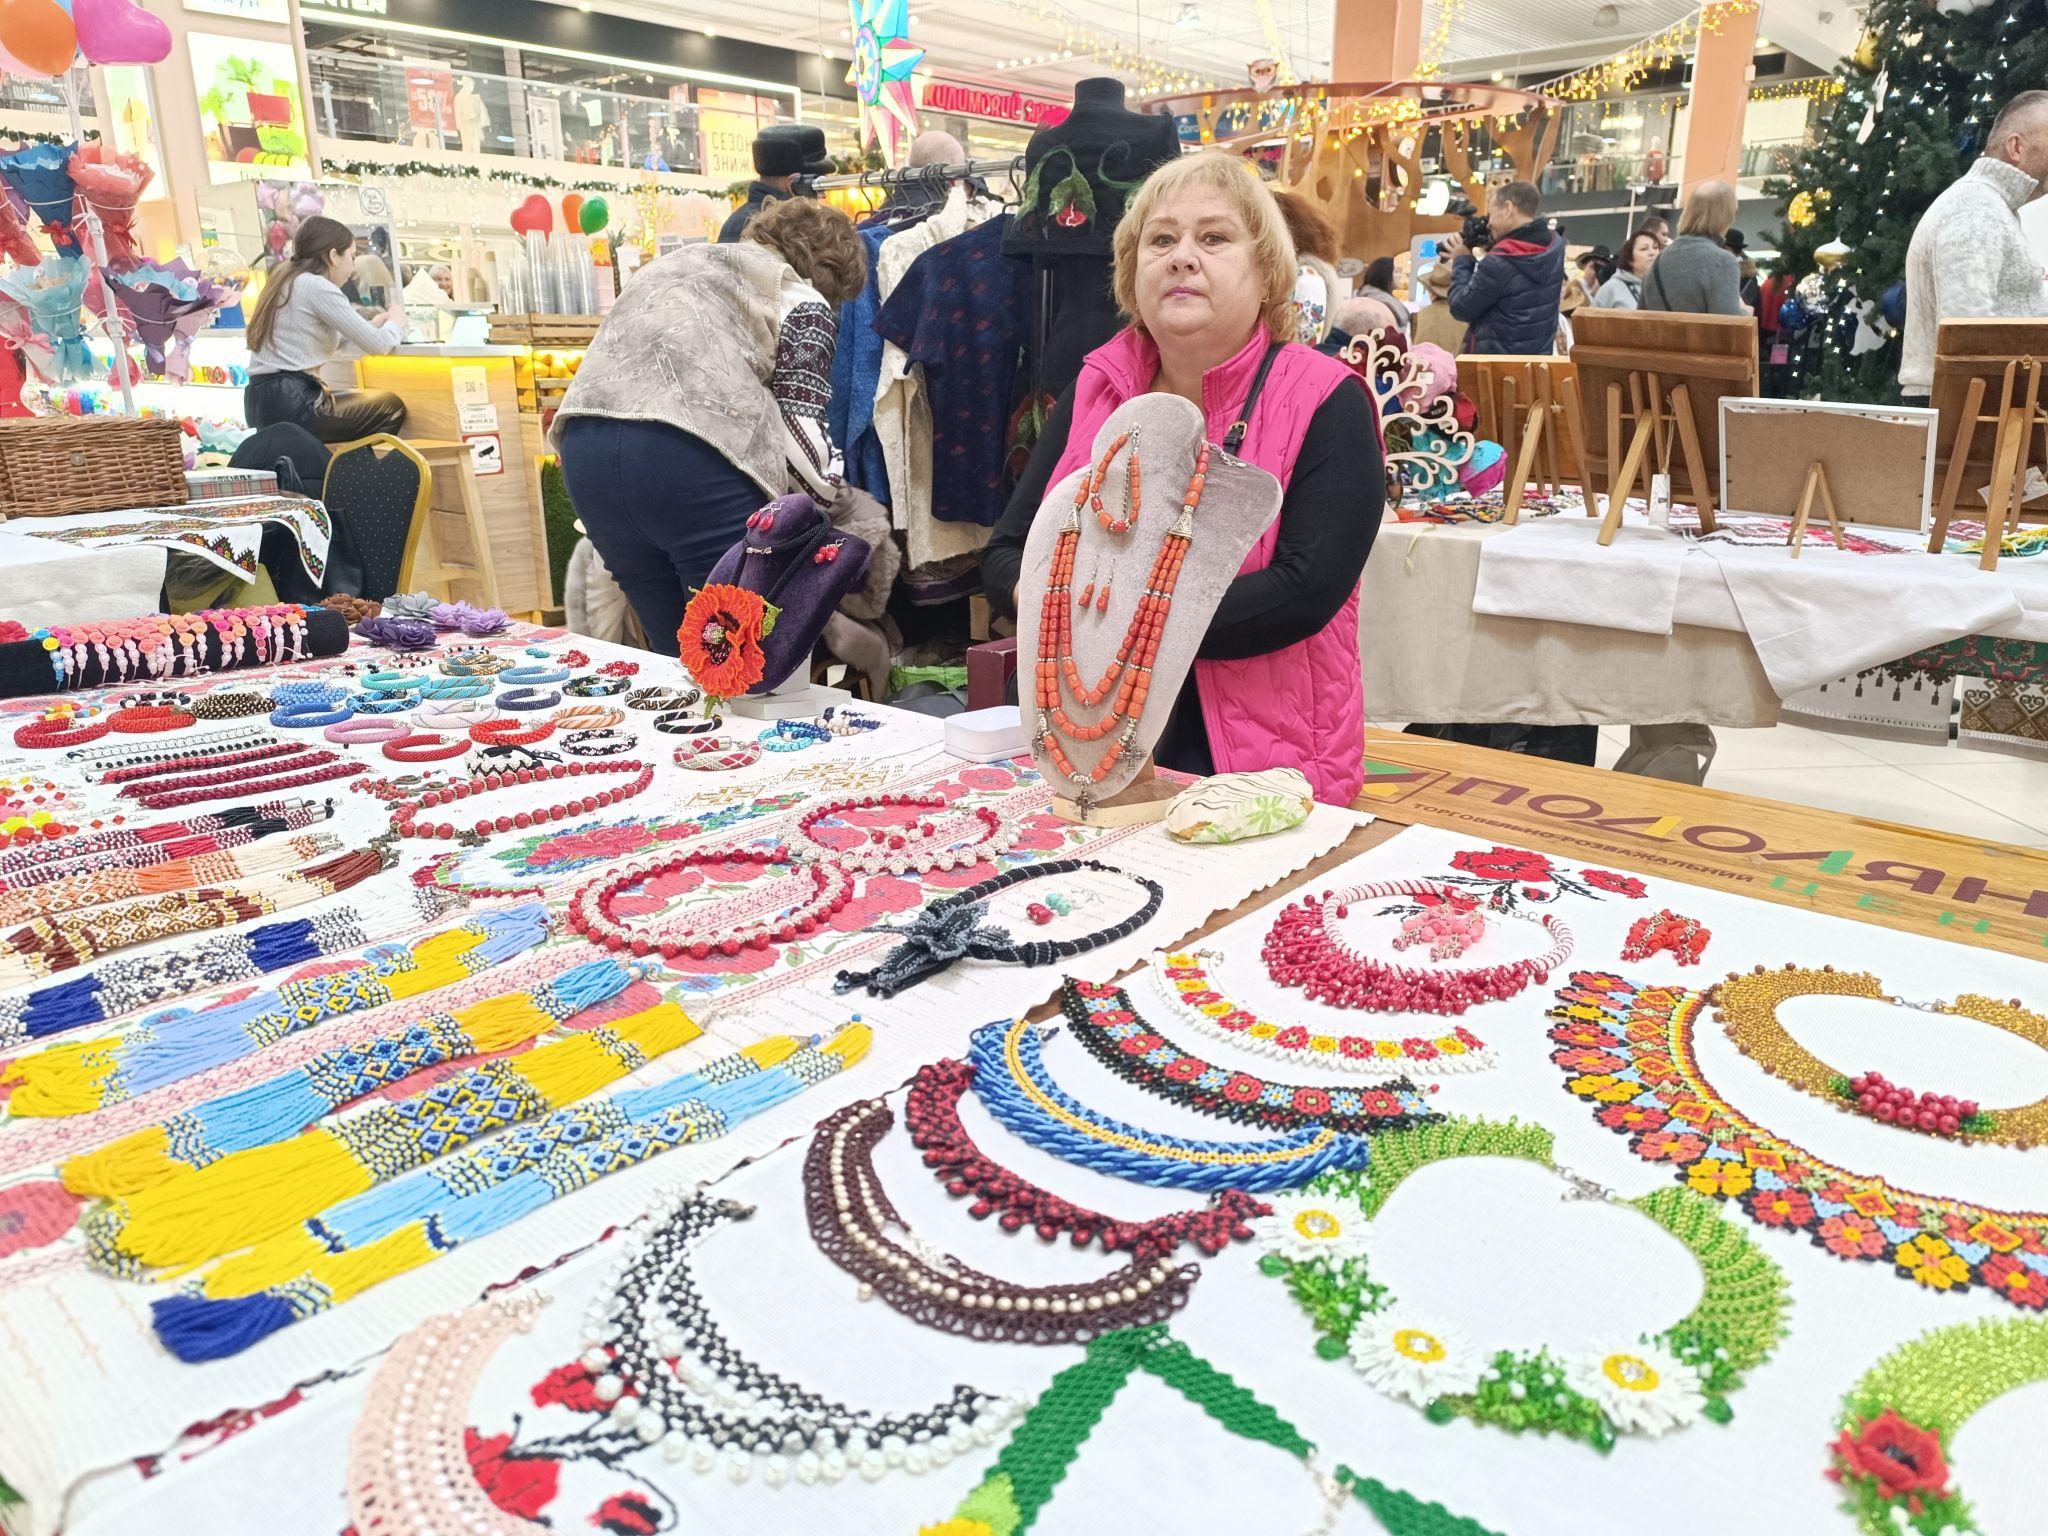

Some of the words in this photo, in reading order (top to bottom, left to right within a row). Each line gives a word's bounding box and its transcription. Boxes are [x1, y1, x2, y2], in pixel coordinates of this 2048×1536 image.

[714, 155, 750, 173] ЗНИЖ
[1414, 803, 1754, 883] ТОРГОВЕЛЬНО-РОЗВАЖАЛЬНИЙ
[1445, 777, 2048, 918] ПОДОЛЯН
